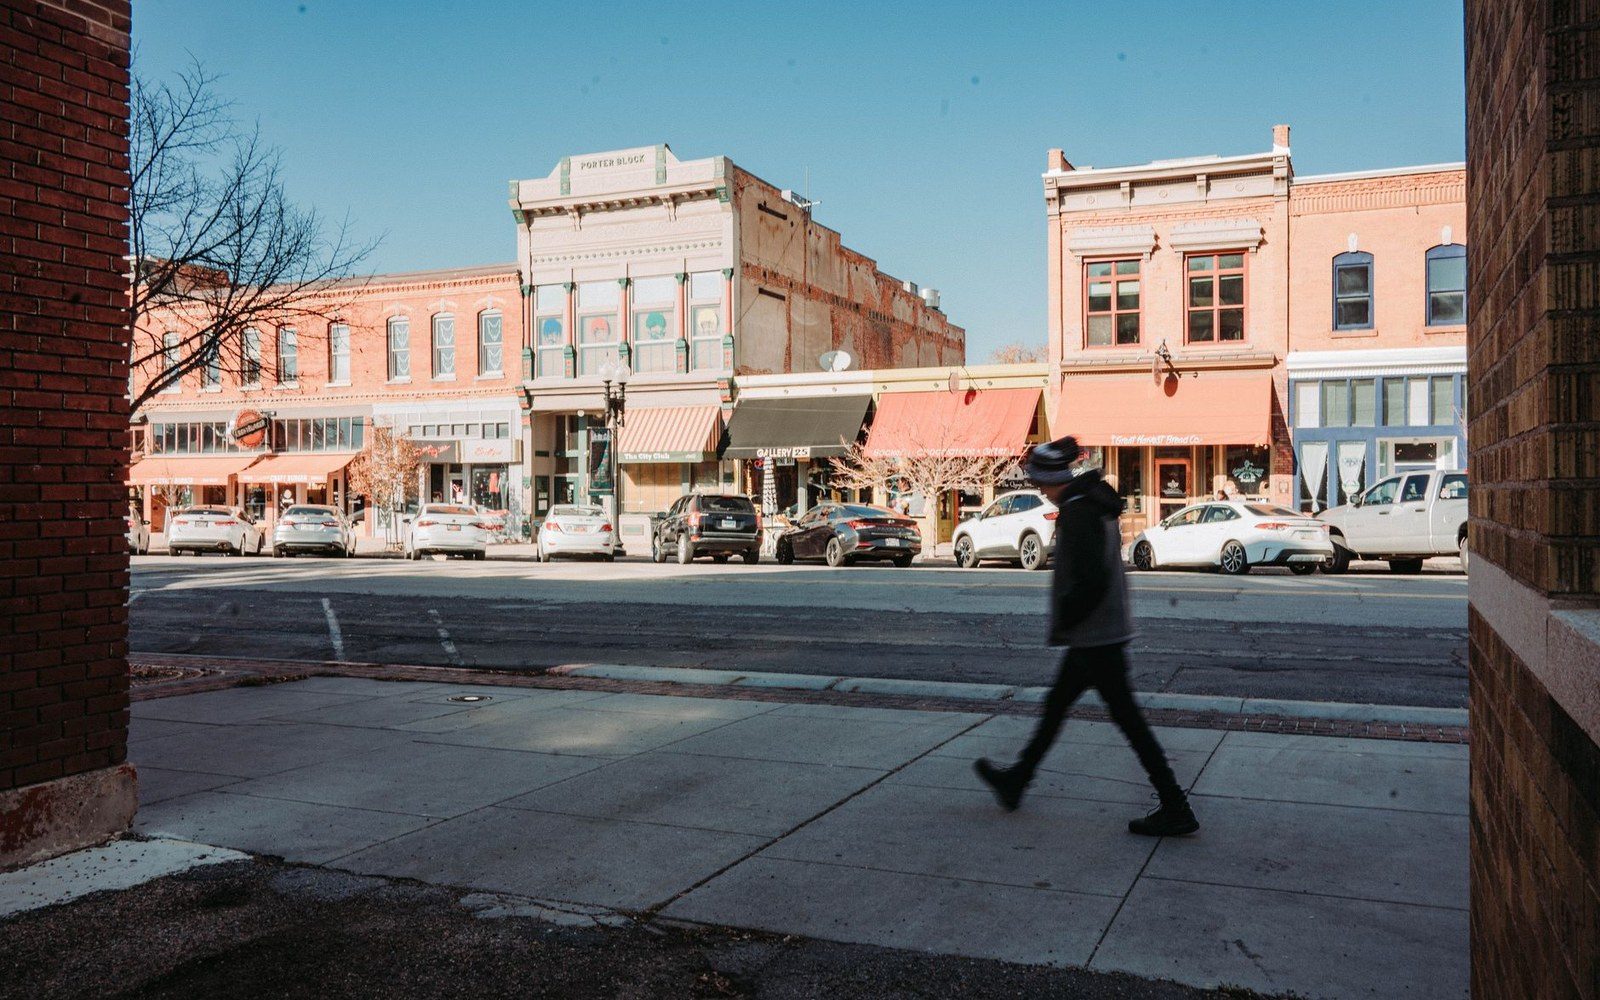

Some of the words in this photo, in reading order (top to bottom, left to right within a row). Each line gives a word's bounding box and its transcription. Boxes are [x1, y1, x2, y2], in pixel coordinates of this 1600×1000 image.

[580, 159, 615, 170] PORTER
[616, 154, 645, 166] BLOCK
[1115, 435, 1136, 445] Great
[1137, 434, 1166, 445] Harvest
[1166, 434, 1189, 444] Bread
[638, 452, 652, 461] City
[653, 452, 670, 460] Club
[757, 448, 792, 457] GALLERY
[795, 448, 808, 457] 25
